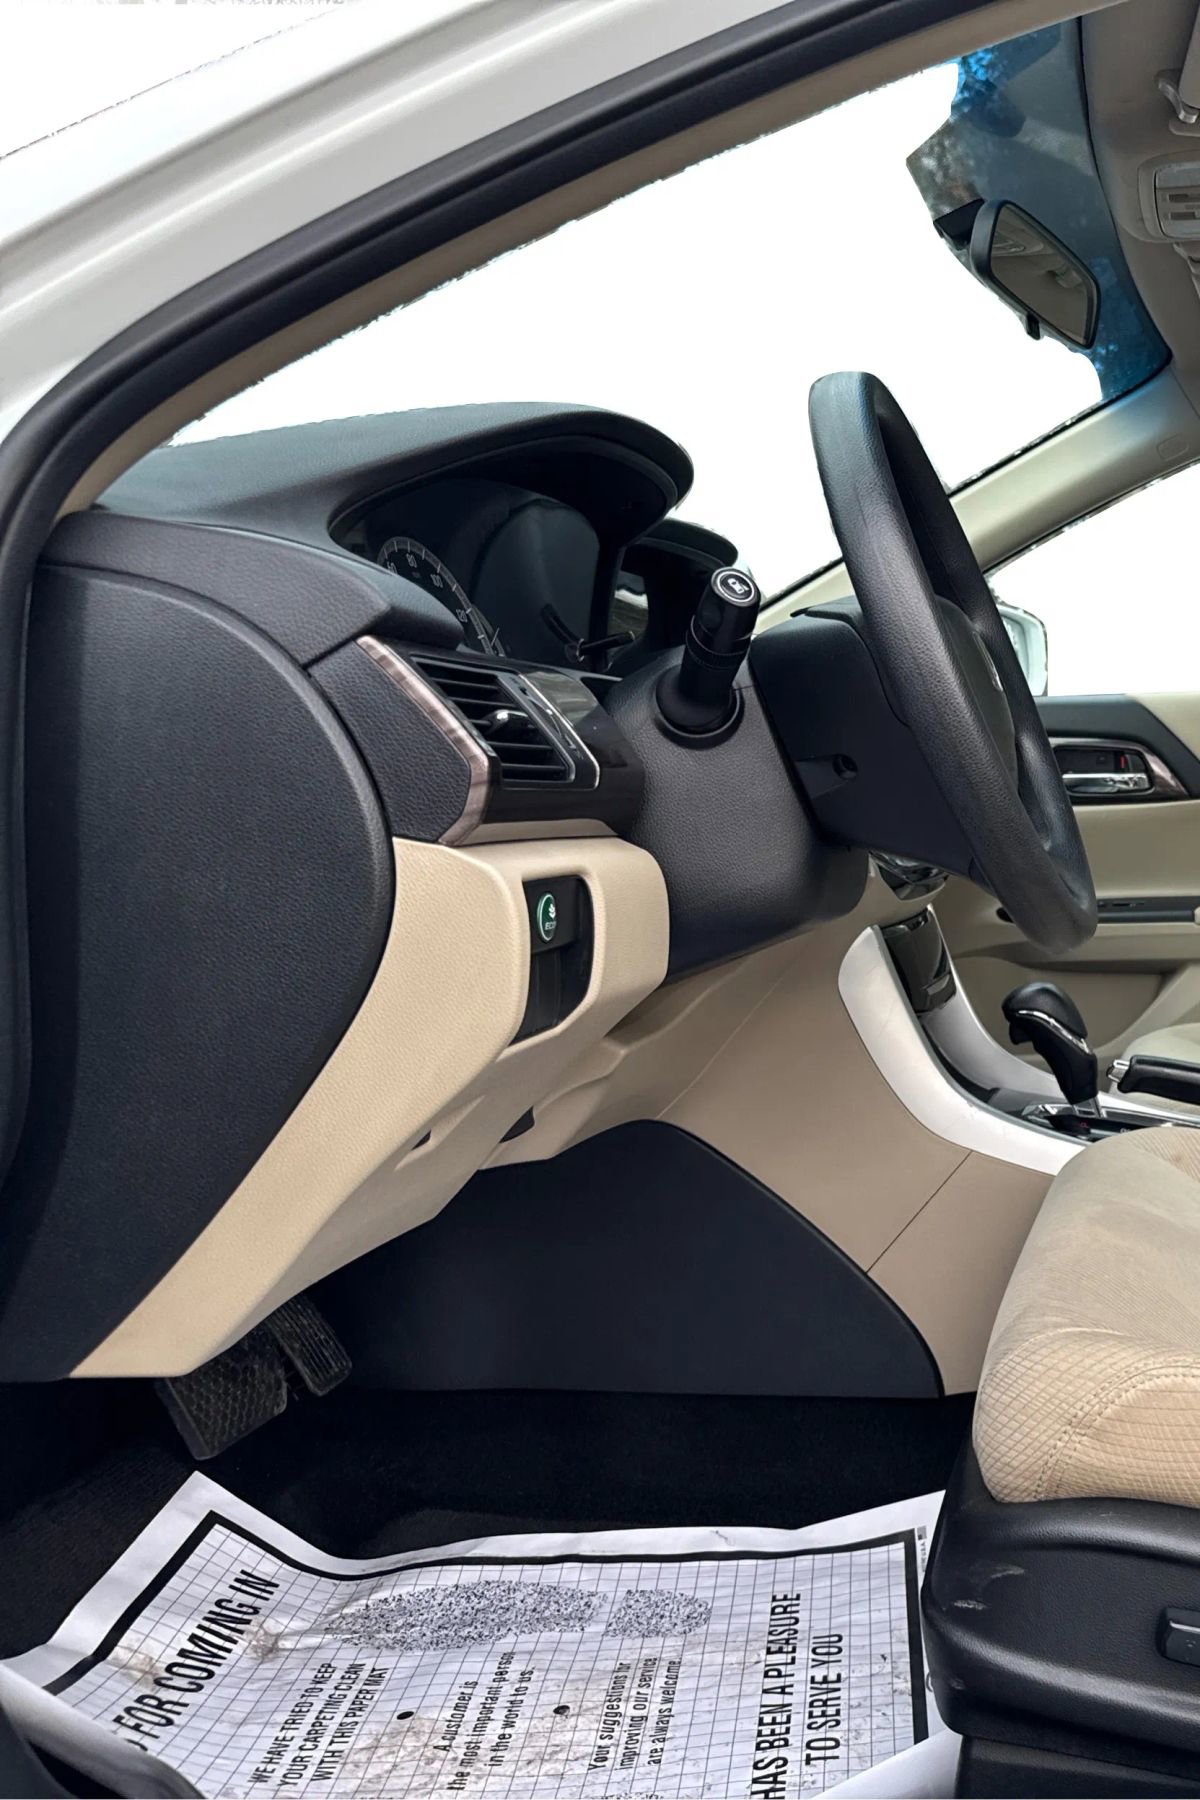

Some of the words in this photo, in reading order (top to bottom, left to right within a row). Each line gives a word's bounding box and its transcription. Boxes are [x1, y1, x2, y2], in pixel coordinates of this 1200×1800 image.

[764, 1593, 801, 1679] PLEASURE
[811, 1633, 844, 1669] YOU
[112, 1694, 190, 1739] FOR
[154, 1598, 262, 1693] COMING
[228, 1569, 280, 1601] IN
[492, 1651, 516, 1682] person
[613, 1662, 632, 1673] for
[310, 1662, 337, 1685] KEEP
[459, 1680, 479, 1689] is
[300, 1687, 324, 1700] TO
[509, 1686, 529, 1696] to
[762, 1683, 795, 1696] A
[806, 1672, 842, 1731] SERVE
[280, 1701, 314, 1732] TRIED
[441, 1691, 474, 1741] customer
[466, 1686, 503, 1737] important
[501, 1700, 524, 1730] world
[599, 1674, 628, 1740] suggestions
[277, 1755, 313, 1787] YOUR
[298, 1693, 348, 1751] CARPETING
[334, 1663, 366, 1691] CLEAN
[310, 1750, 344, 1782] WITH
[329, 1721, 359, 1746] THIS
[344, 1688, 379, 1718] PAPER
[363, 1667, 390, 1686] MAT
[615, 1715, 649, 1771] improving
[632, 1691, 649, 1711] our
[649, 1707, 675, 1744] always
[755, 1702, 793, 1752] BEEN
[261, 1736, 295, 1764] HAVE
[433, 1744, 452, 1752] A
[459, 1740, 482, 1767] most
[490, 1733, 513, 1752] the
[647, 1747, 664, 1766] are
[805, 1736, 841, 1766] TO
[483, 1755, 505, 1767] in
[588, 1745, 611, 1771] Your
[247, 1767, 276, 1783] WE
[446, 1771, 471, 1790] the
[750, 1756, 789, 1799] HAS
